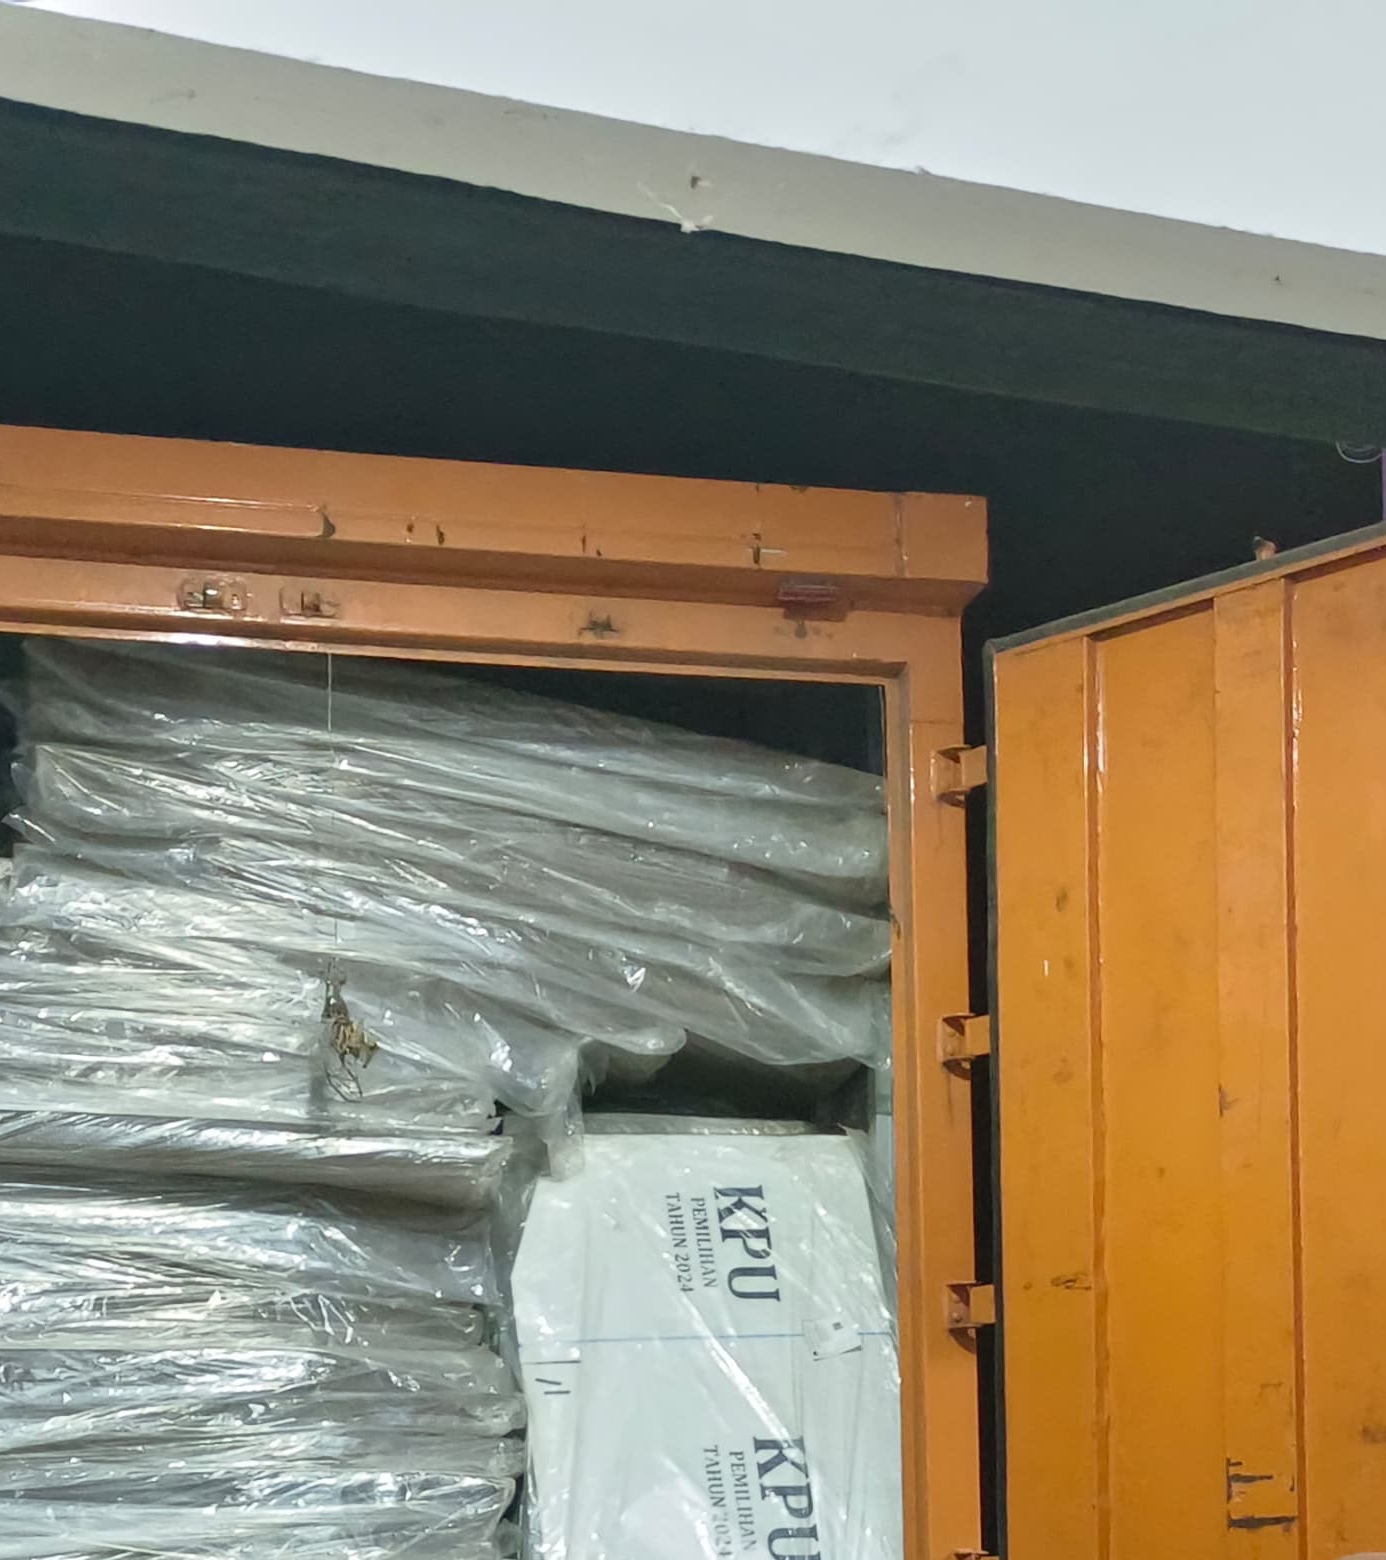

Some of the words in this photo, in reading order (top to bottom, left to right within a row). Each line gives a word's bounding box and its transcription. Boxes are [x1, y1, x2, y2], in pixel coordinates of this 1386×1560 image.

[665, 1192, 688, 1248] TAHUN
[690, 1197, 717, 1289] PEMILIHAN
[713, 1184, 781, 1303] KPU
[674, 1254, 693, 1293] 2024
[703, 1445, 728, 1508] TAHUN
[729, 1450, 757, 1552] PEMILIHAN
